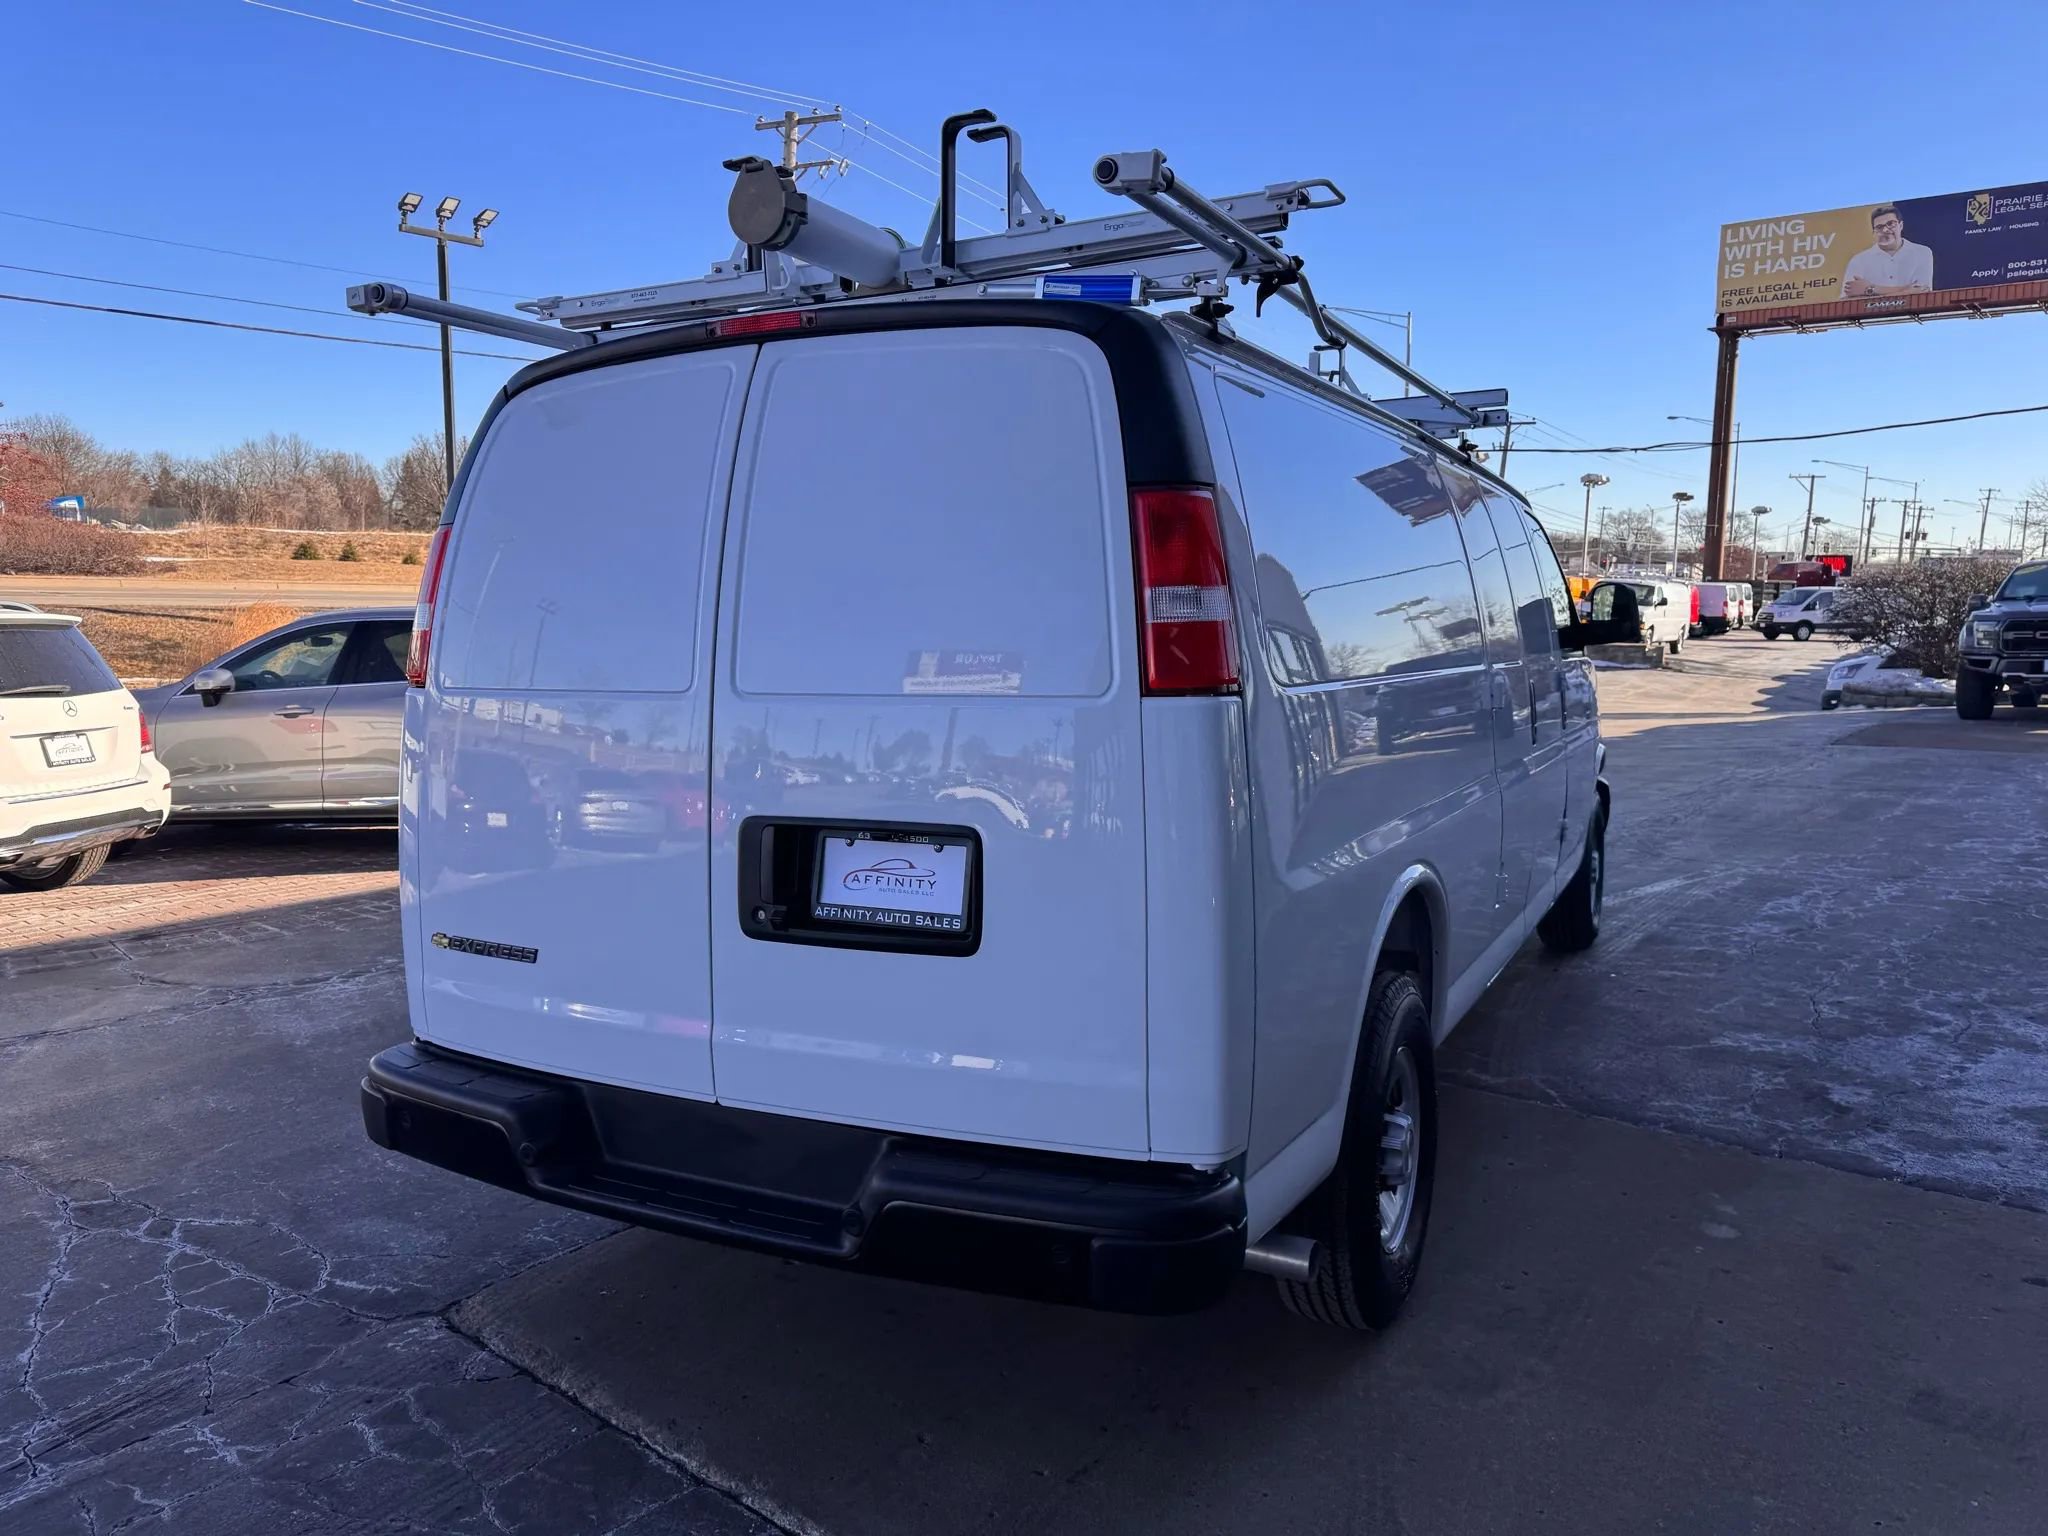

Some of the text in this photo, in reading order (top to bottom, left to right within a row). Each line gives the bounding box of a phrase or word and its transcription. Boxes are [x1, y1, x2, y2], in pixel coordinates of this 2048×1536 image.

[1994, 204, 2027, 214] LEGAL
[1995, 194, 2044, 207] PRAIRIE
[1726, 219, 1805, 243] LIVING
[2009, 221, 2040, 230] HOUSING
[1724, 232, 1837, 261] WITH HIV
[1724, 253, 1825, 280] IS HARD
[1971, 268, 1999, 278] Apply
[1721, 277, 1838, 298] FREE LEGAL HELP
[1721, 290, 1805, 308] IS AVAILABLE
[851, 873, 937, 890] AFFINITY
[814, 906, 961, 929] AFFINITY AUTO SALES
[449, 936, 538, 963] EXPRESS
